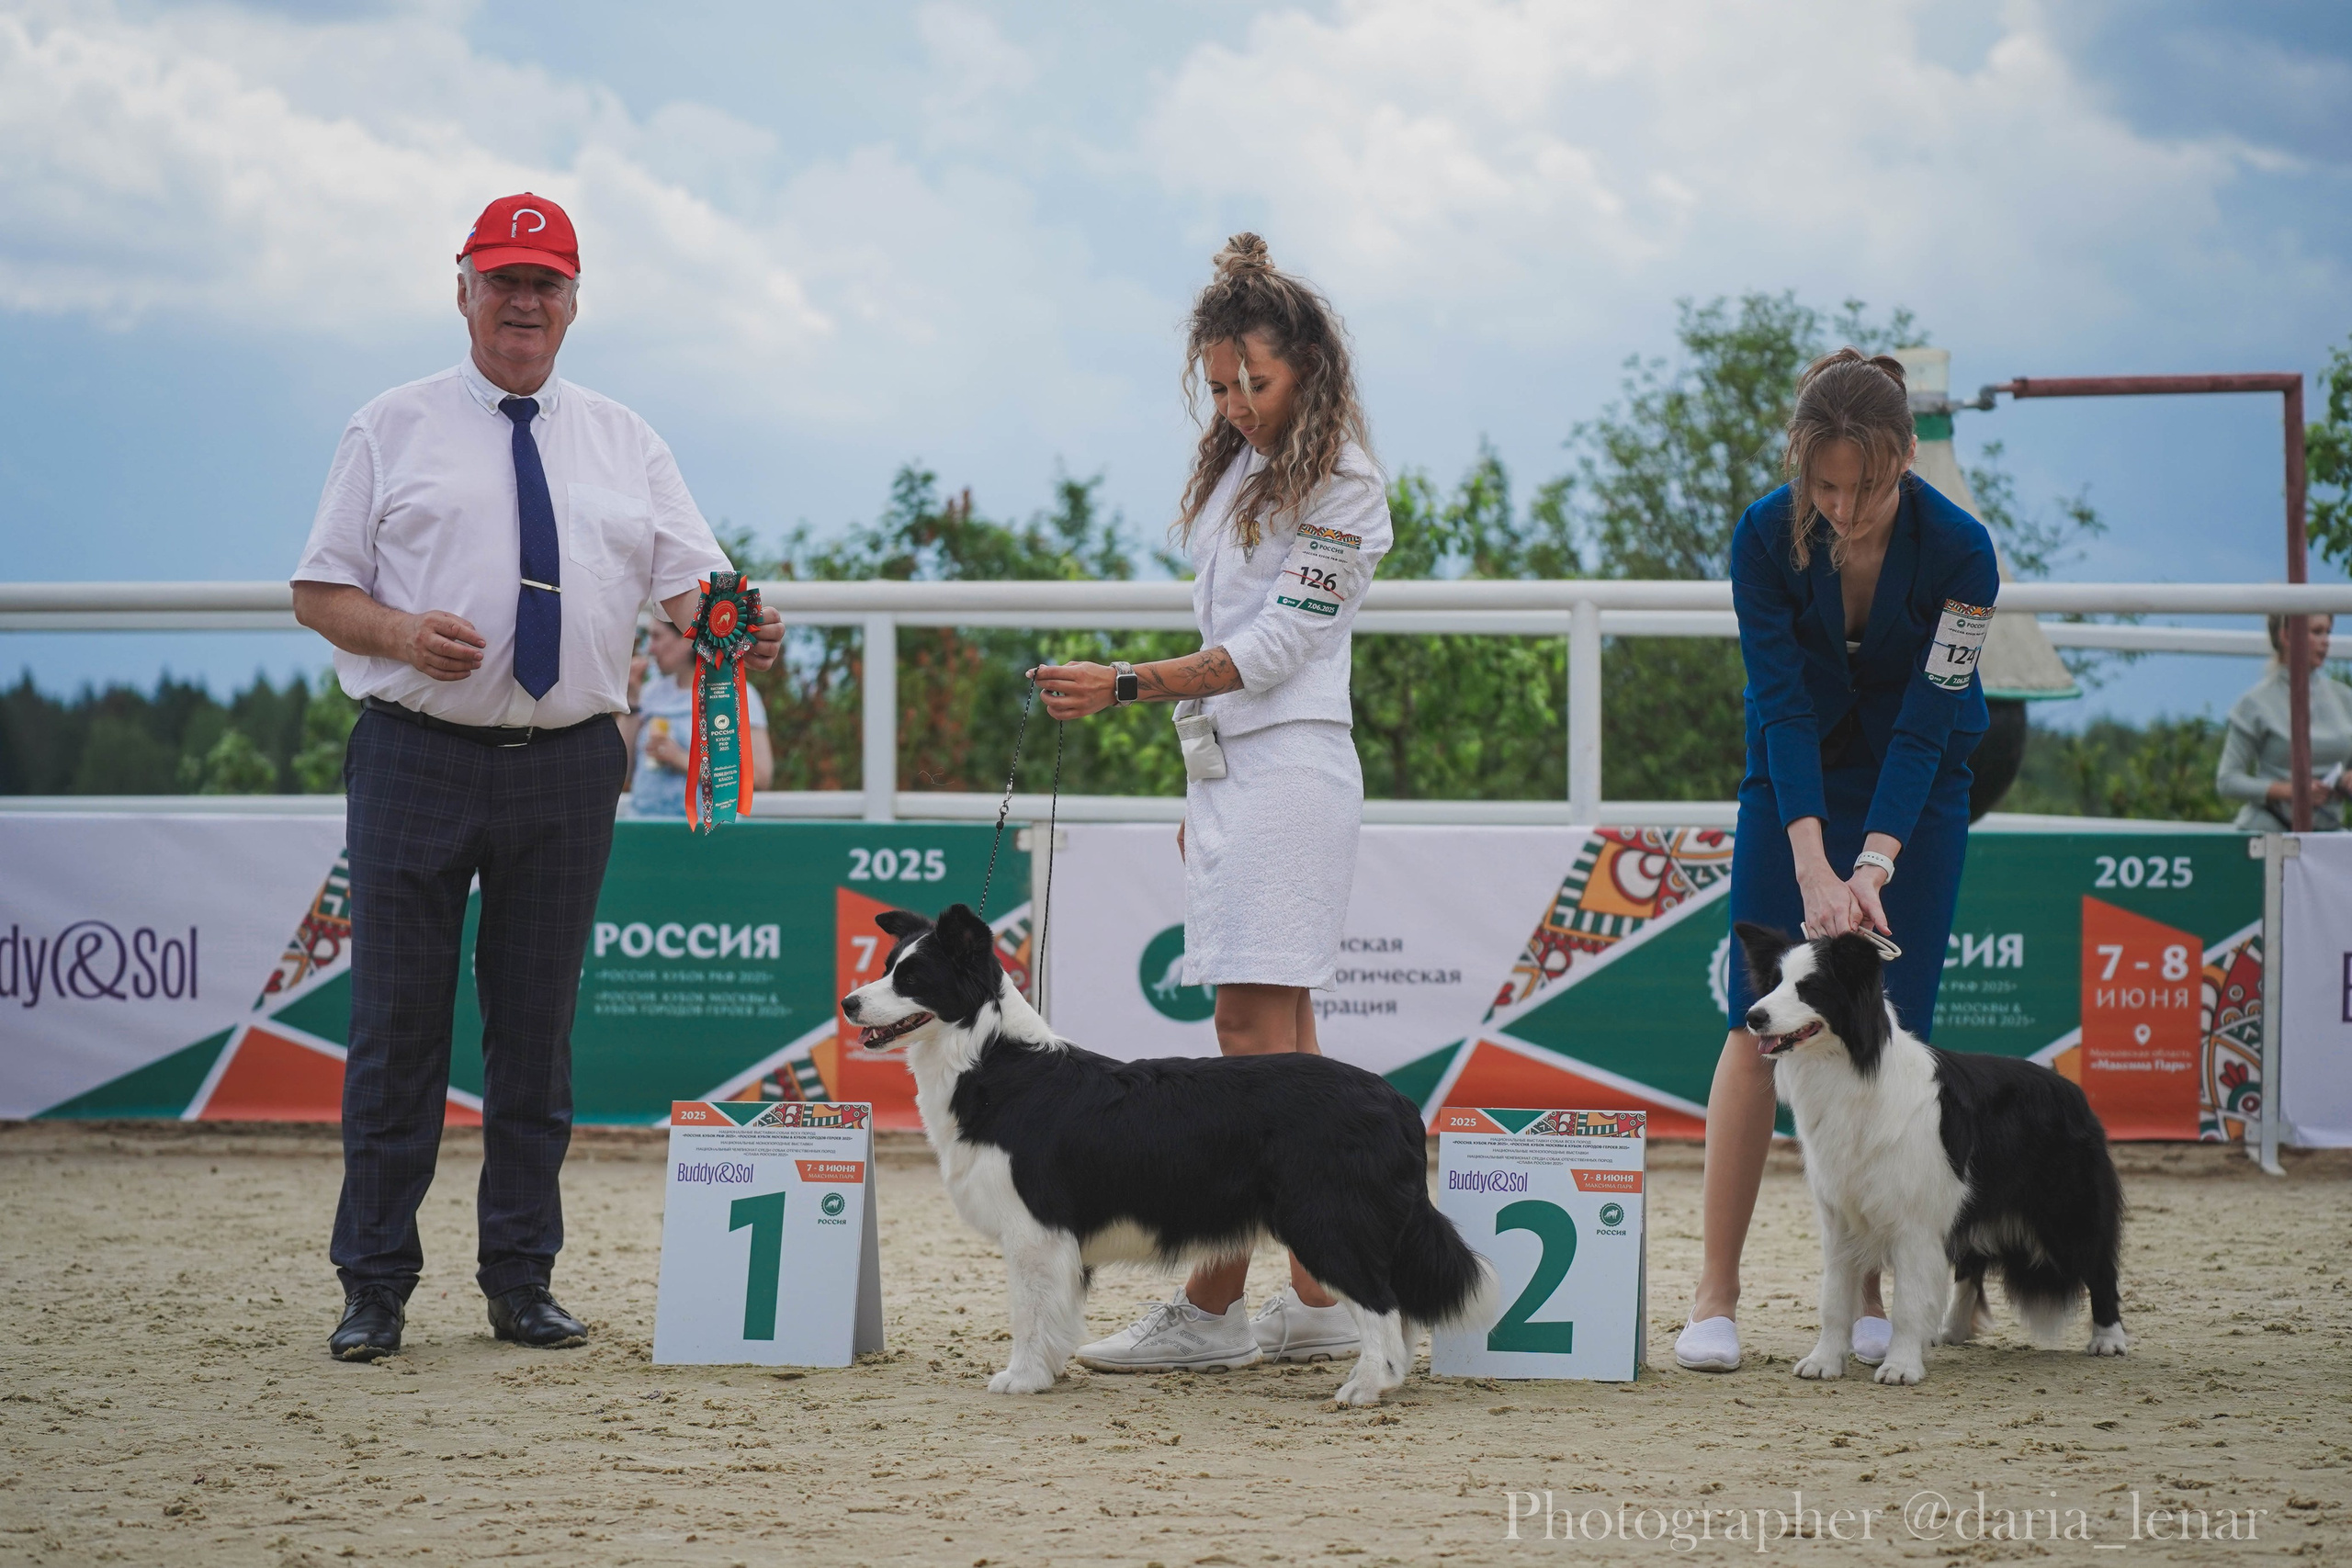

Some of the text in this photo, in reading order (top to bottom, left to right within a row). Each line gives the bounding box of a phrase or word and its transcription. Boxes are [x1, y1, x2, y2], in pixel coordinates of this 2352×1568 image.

[1319, 545, 1343, 555] РОССИЯ
[1299, 566, 1337, 592] 126
[1307, 602, 1335, 613] 7.06.2025
[1947, 644, 1977, 664] 124
[848, 848, 946, 882] 2025
[2095, 856, 2193, 888] 2025
[594, 922, 780, 959] РОССИЯ
[851, 935, 878, 972] 7
[2098, 944, 2123, 981] 7
[2162, 944, 2189, 981] 8
[2097, 987, 2188, 1009] ИЮНЯ
[681, 1111, 707, 1120] 2025
[1450, 1117, 1476, 1127] 2025
[807, 1164, 812, 1172] 7
[819, 1164, 825, 1172] 8
[826, 1165, 855, 1173] ИЮНЯ
[1583, 1173, 1589, 1181] 7
[1603, 1174, 1634, 1182] ИЮНЯ
[729, 1190, 786, 1341] 1
[1487, 1200, 1577, 1354] 2
